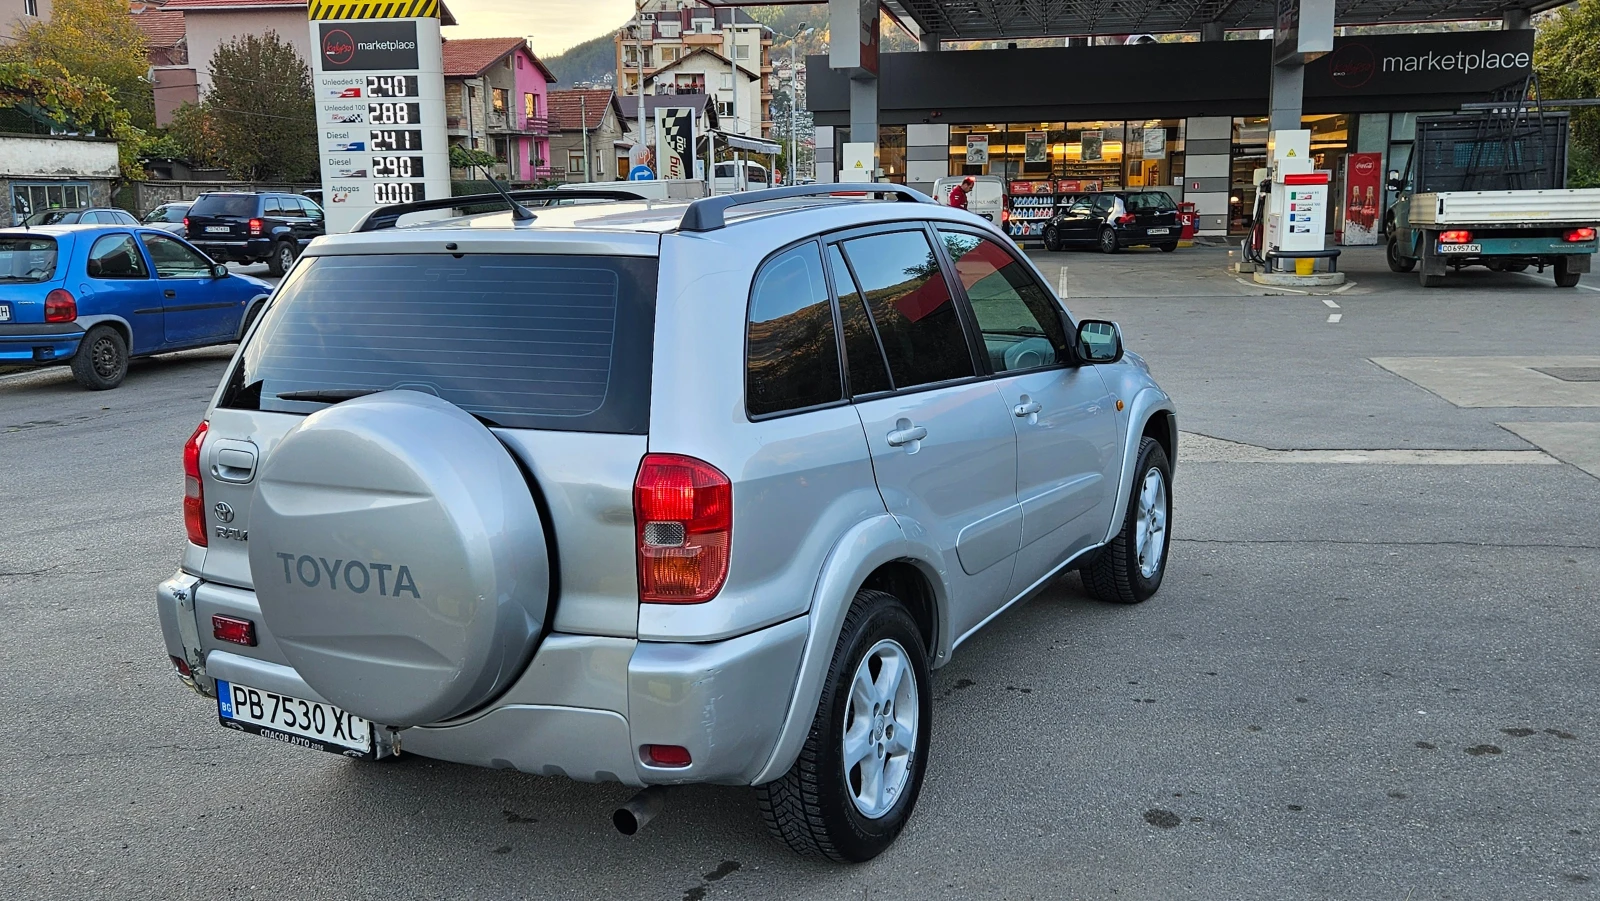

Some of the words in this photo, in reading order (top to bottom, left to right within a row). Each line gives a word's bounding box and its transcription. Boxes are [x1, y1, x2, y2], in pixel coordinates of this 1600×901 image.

[357, 40, 416, 52] marketplace
[1382, 48, 1530, 75] marketplace
[322, 78, 354, 86] Unleaded
[367, 75, 406, 97] 2.40
[326, 131, 349, 139] Diesel
[371, 130, 410, 151] 2.41
[676, 135, 684, 154] 100
[328, 158, 352, 166] Diesel
[669, 155, 681, 179] ing
[331, 185, 360, 193] Autogas
[1452, 244, 1470, 252] 6957
[0, 307, 8, 317] H
[276, 552, 421, 599] TOYOTA
[221, 701, 232, 713] BG
[232, 685, 264, 721] PB
[266, 693, 326, 735] 7530
[331, 706, 365, 743] XC
[260, 728, 290, 743] СПАСОВ
[290, 735, 310, 748] АУТО
